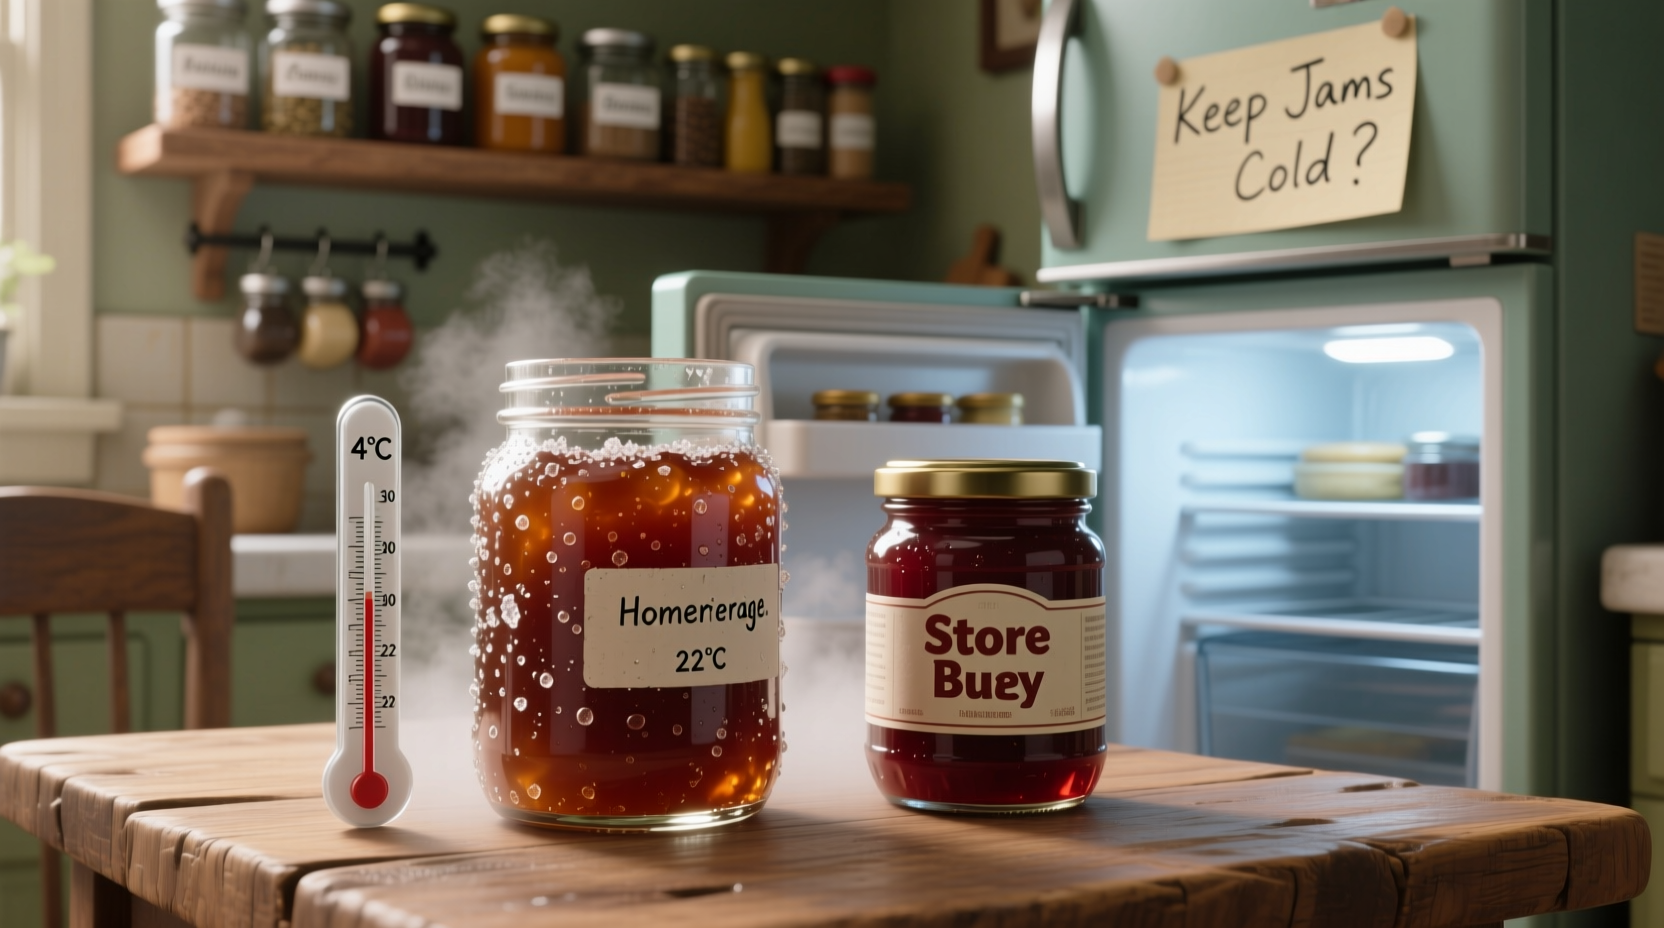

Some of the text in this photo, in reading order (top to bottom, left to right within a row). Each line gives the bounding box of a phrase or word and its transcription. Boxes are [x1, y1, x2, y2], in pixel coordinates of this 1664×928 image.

[1174, 57, 1394, 144] Keep Jams
[1235, 131, 1335, 201] Cold
[350, 436, 392, 460] 4°C
[380, 643, 397, 657] 22
[925, 614, 1050, 656] Store
[675, 647, 727, 673] 22°C
[933, 660, 1045, 709] Buey
